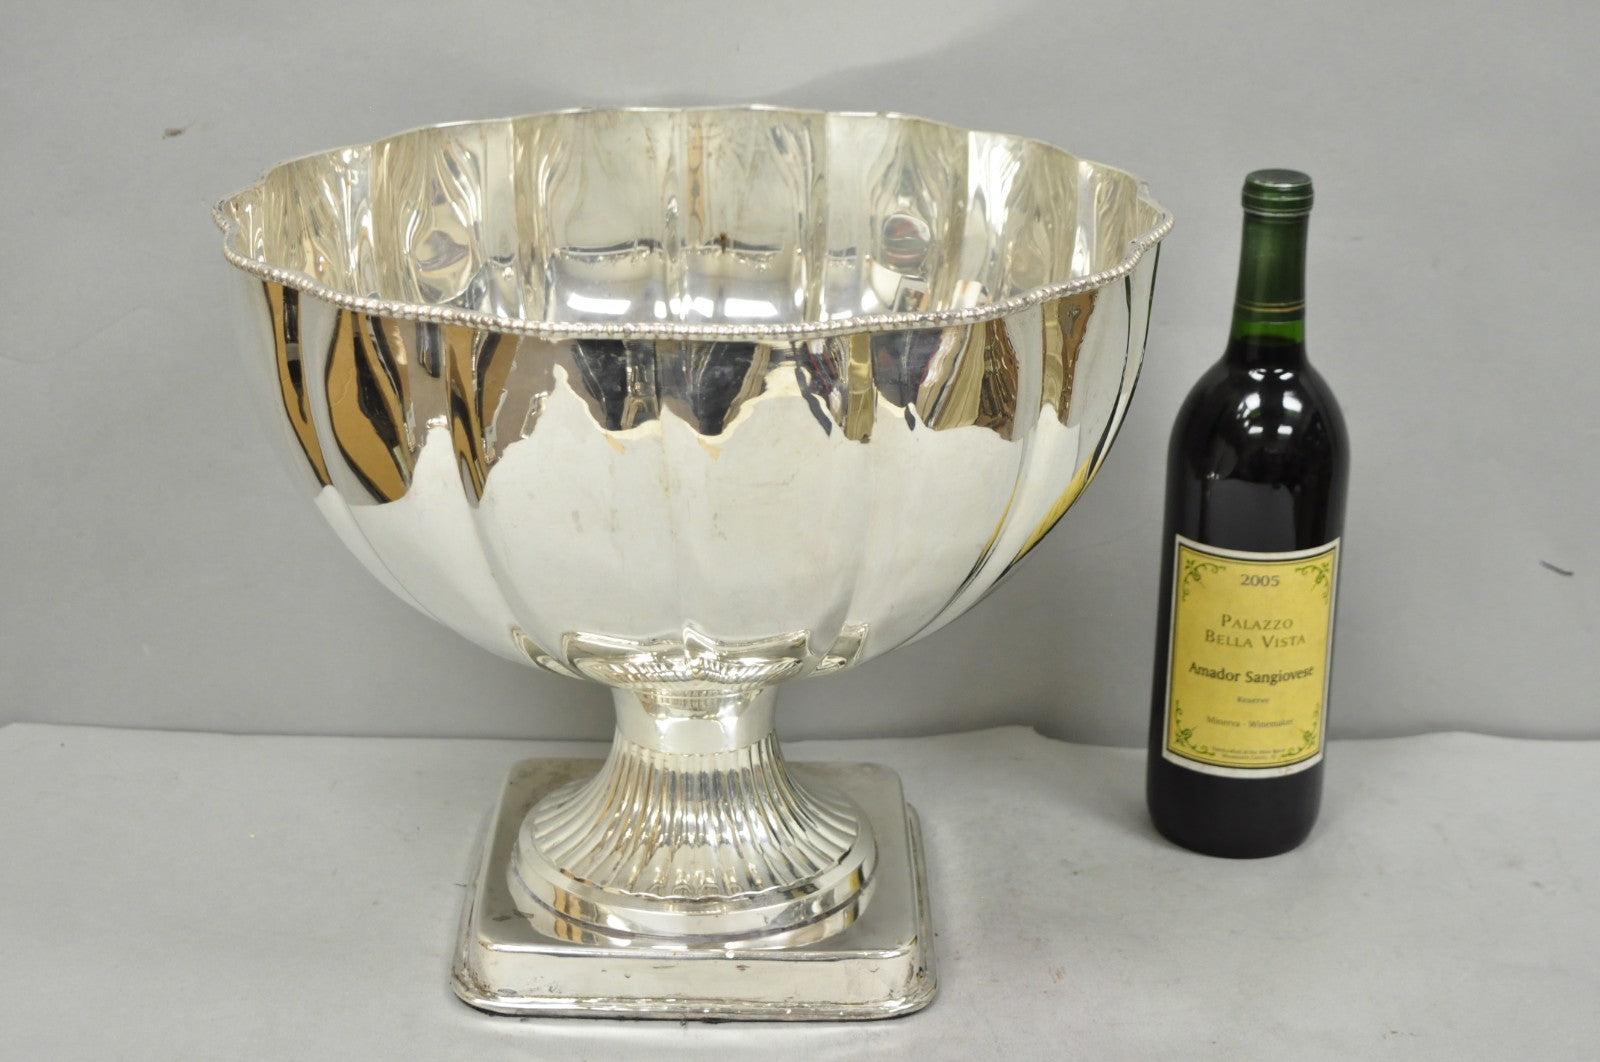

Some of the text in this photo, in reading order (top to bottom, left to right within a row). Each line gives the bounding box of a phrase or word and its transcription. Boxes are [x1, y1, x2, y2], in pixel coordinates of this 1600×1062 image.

[1240, 573, 1280, 587] 2005
[1221, 614, 1293, 630] PALAZZO
[1205, 629, 1306, 648] BELLA VISTA
[1189, 662, 1314, 686] Amador Sangiovese
